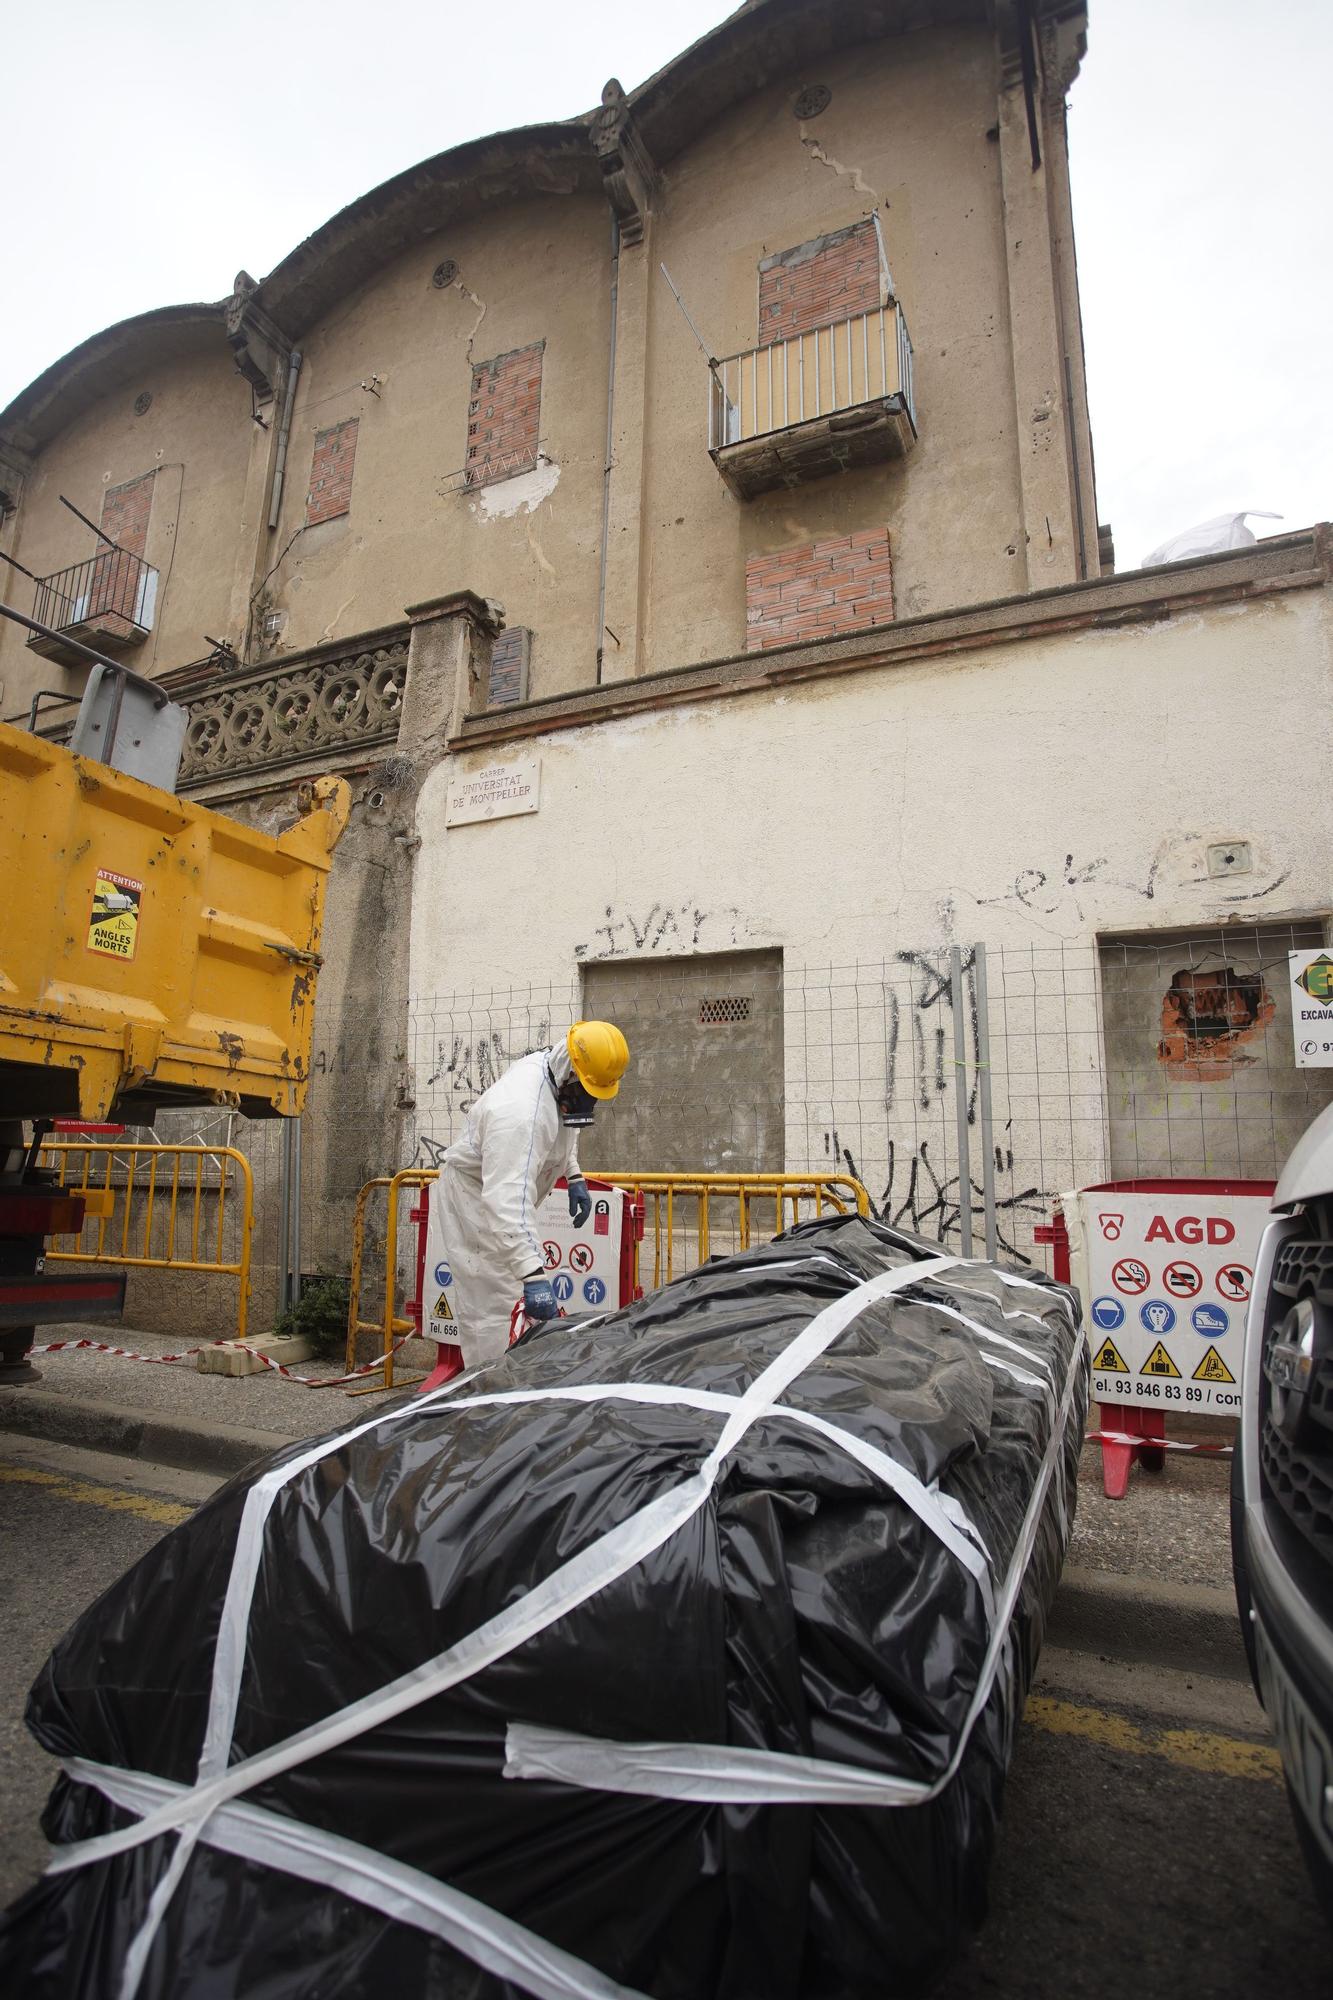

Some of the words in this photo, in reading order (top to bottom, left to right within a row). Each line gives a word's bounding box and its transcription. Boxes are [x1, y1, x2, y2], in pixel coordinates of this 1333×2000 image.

[480, 768, 506, 779] CARRER
[462, 774, 523, 795] UNIVERSITAT
[453, 797, 465, 809] DE
[469, 785, 531, 807] MONTPELLER
[97, 869, 143, 890] ATTENTION
[94, 928, 131, 945] ANGLES
[94, 938, 128, 954] MORTS
[1144, 1215, 1236, 1245] AGD
[430, 1322, 442, 1334] Tel.
[444, 1324, 458, 1337] 656
[1093, 1377, 1112, 1392] el.
[1116, 1380, 1132, 1394] 93
[1136, 1383, 1160, 1397] 846
[1165, 1385, 1181, 1399] 83
[1186, 1388, 1202, 1402] 89
